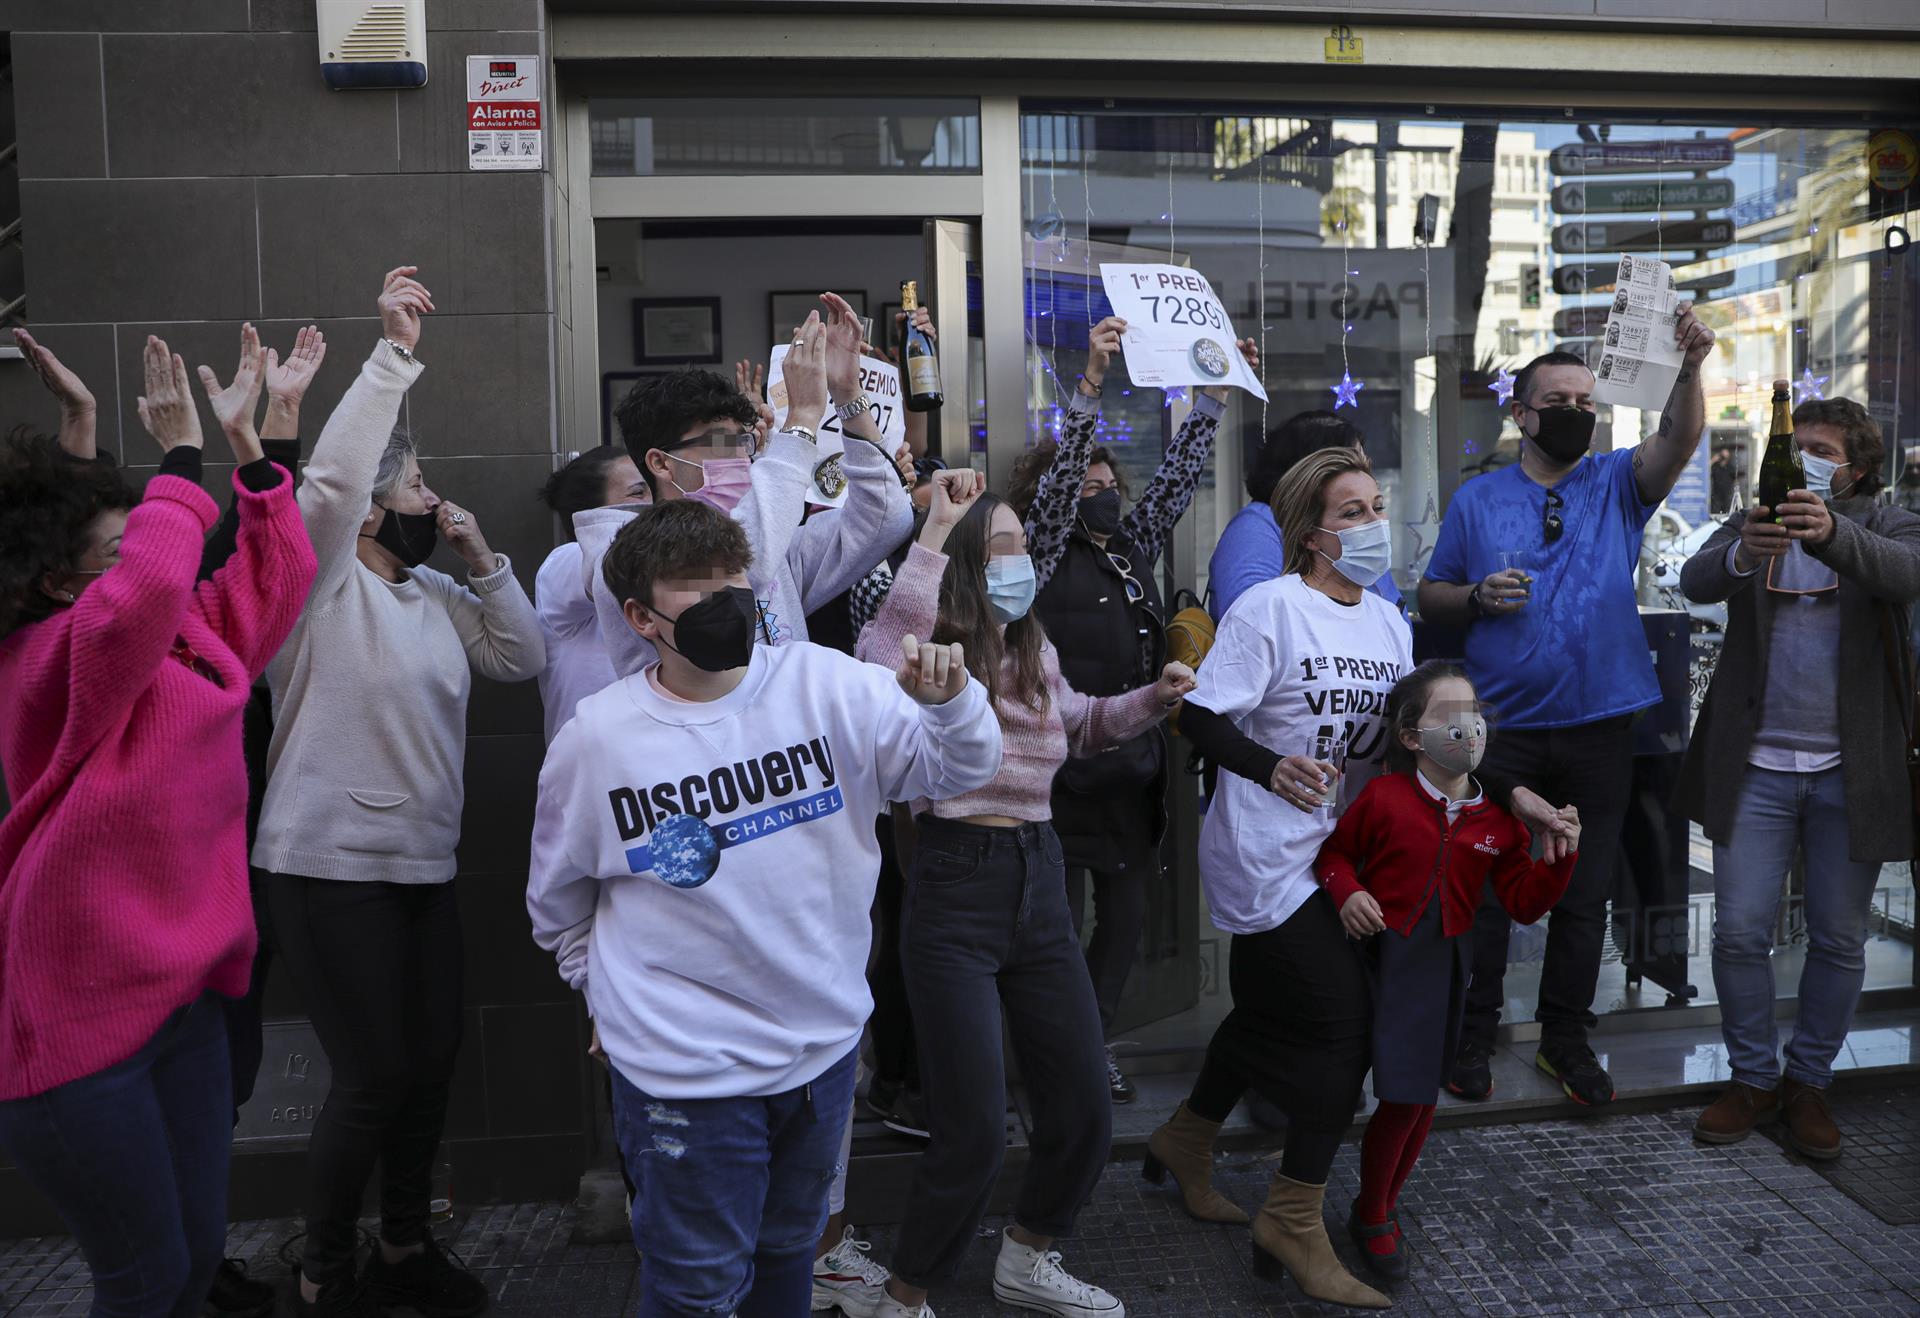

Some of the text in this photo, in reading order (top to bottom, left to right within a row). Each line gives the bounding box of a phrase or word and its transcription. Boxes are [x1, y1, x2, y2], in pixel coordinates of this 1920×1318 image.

[479, 76, 529, 97] Direct
[473, 105, 537, 119] Alarma
[1130, 272, 1219, 305] 1er PREMI
[1140, 295, 1229, 336] 72897
[859, 368, 897, 397] REMIO
[1300, 656, 1329, 681] 1er
[725, 795, 840, 841] CHANNEL
[270, 1105, 323, 1122] AGU
